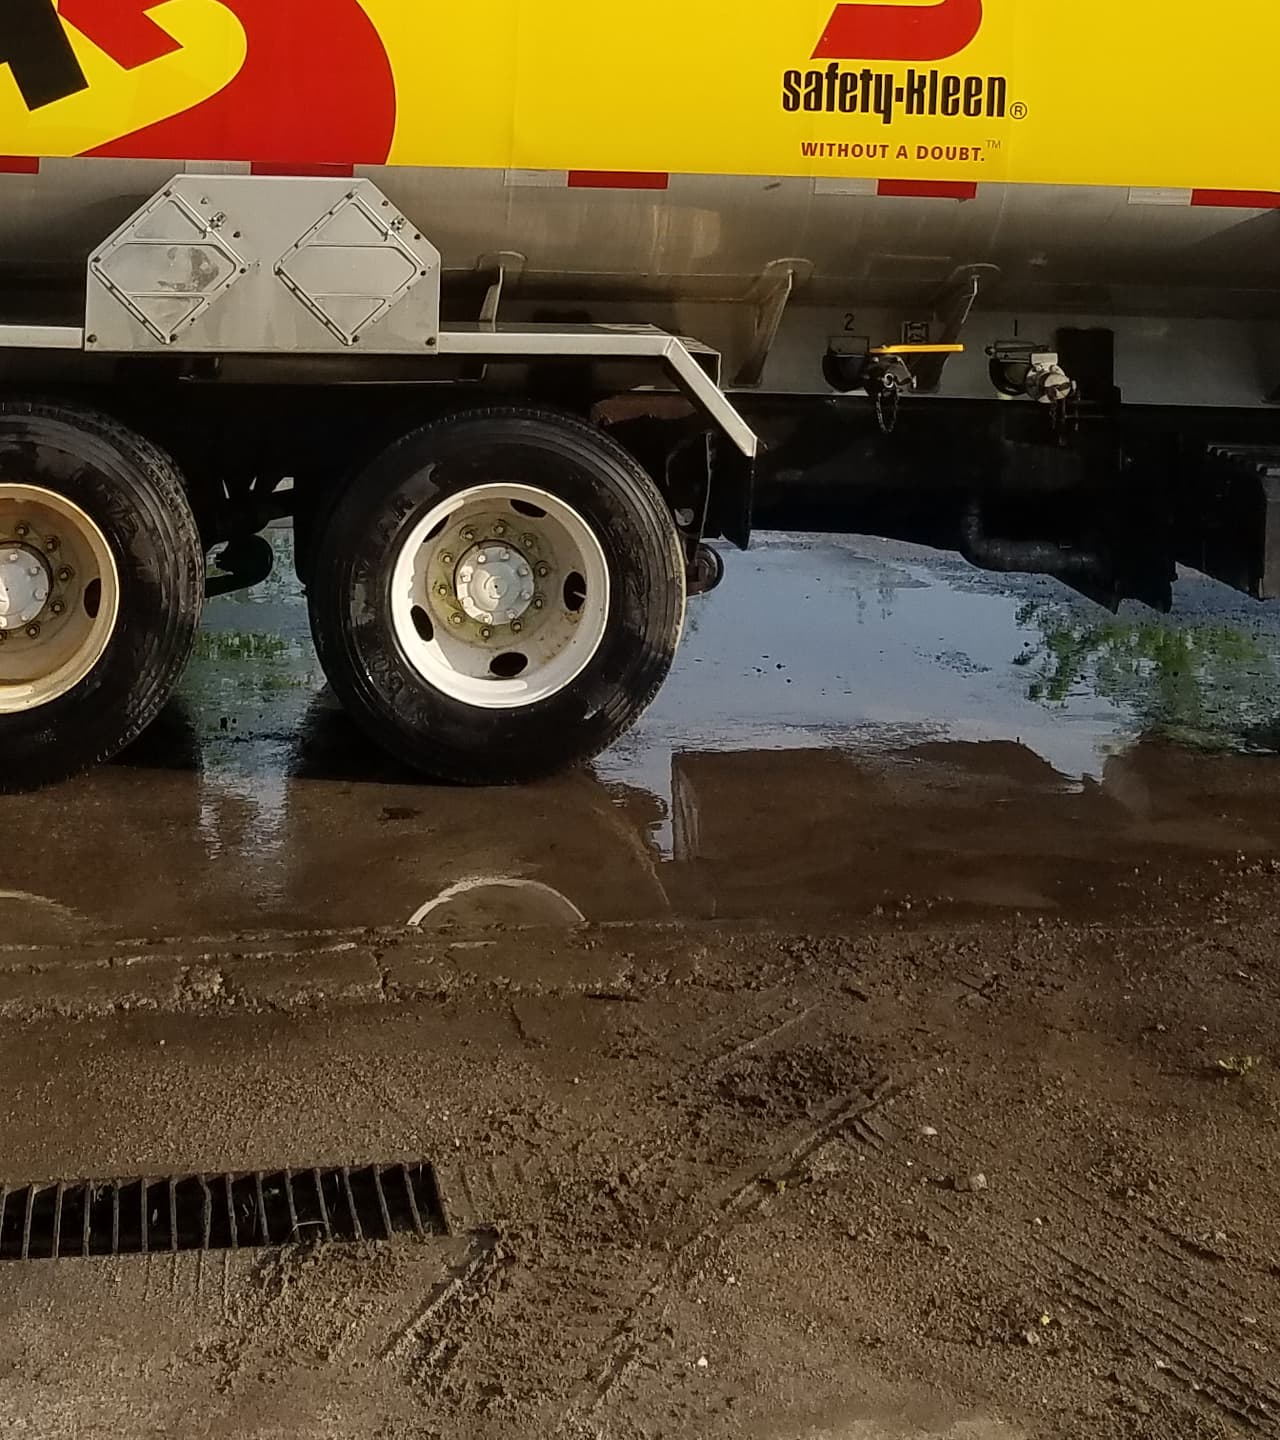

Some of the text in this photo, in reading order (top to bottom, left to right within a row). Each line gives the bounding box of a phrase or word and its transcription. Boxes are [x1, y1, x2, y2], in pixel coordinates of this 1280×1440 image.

[782, 62, 1007, 124] safety-kleen
[801, 142, 889, 160] WITHOUT
[896, 145, 909, 160] A
[916, 146, 986, 162] DOUBT.
[844, 313, 855, 332] 2
